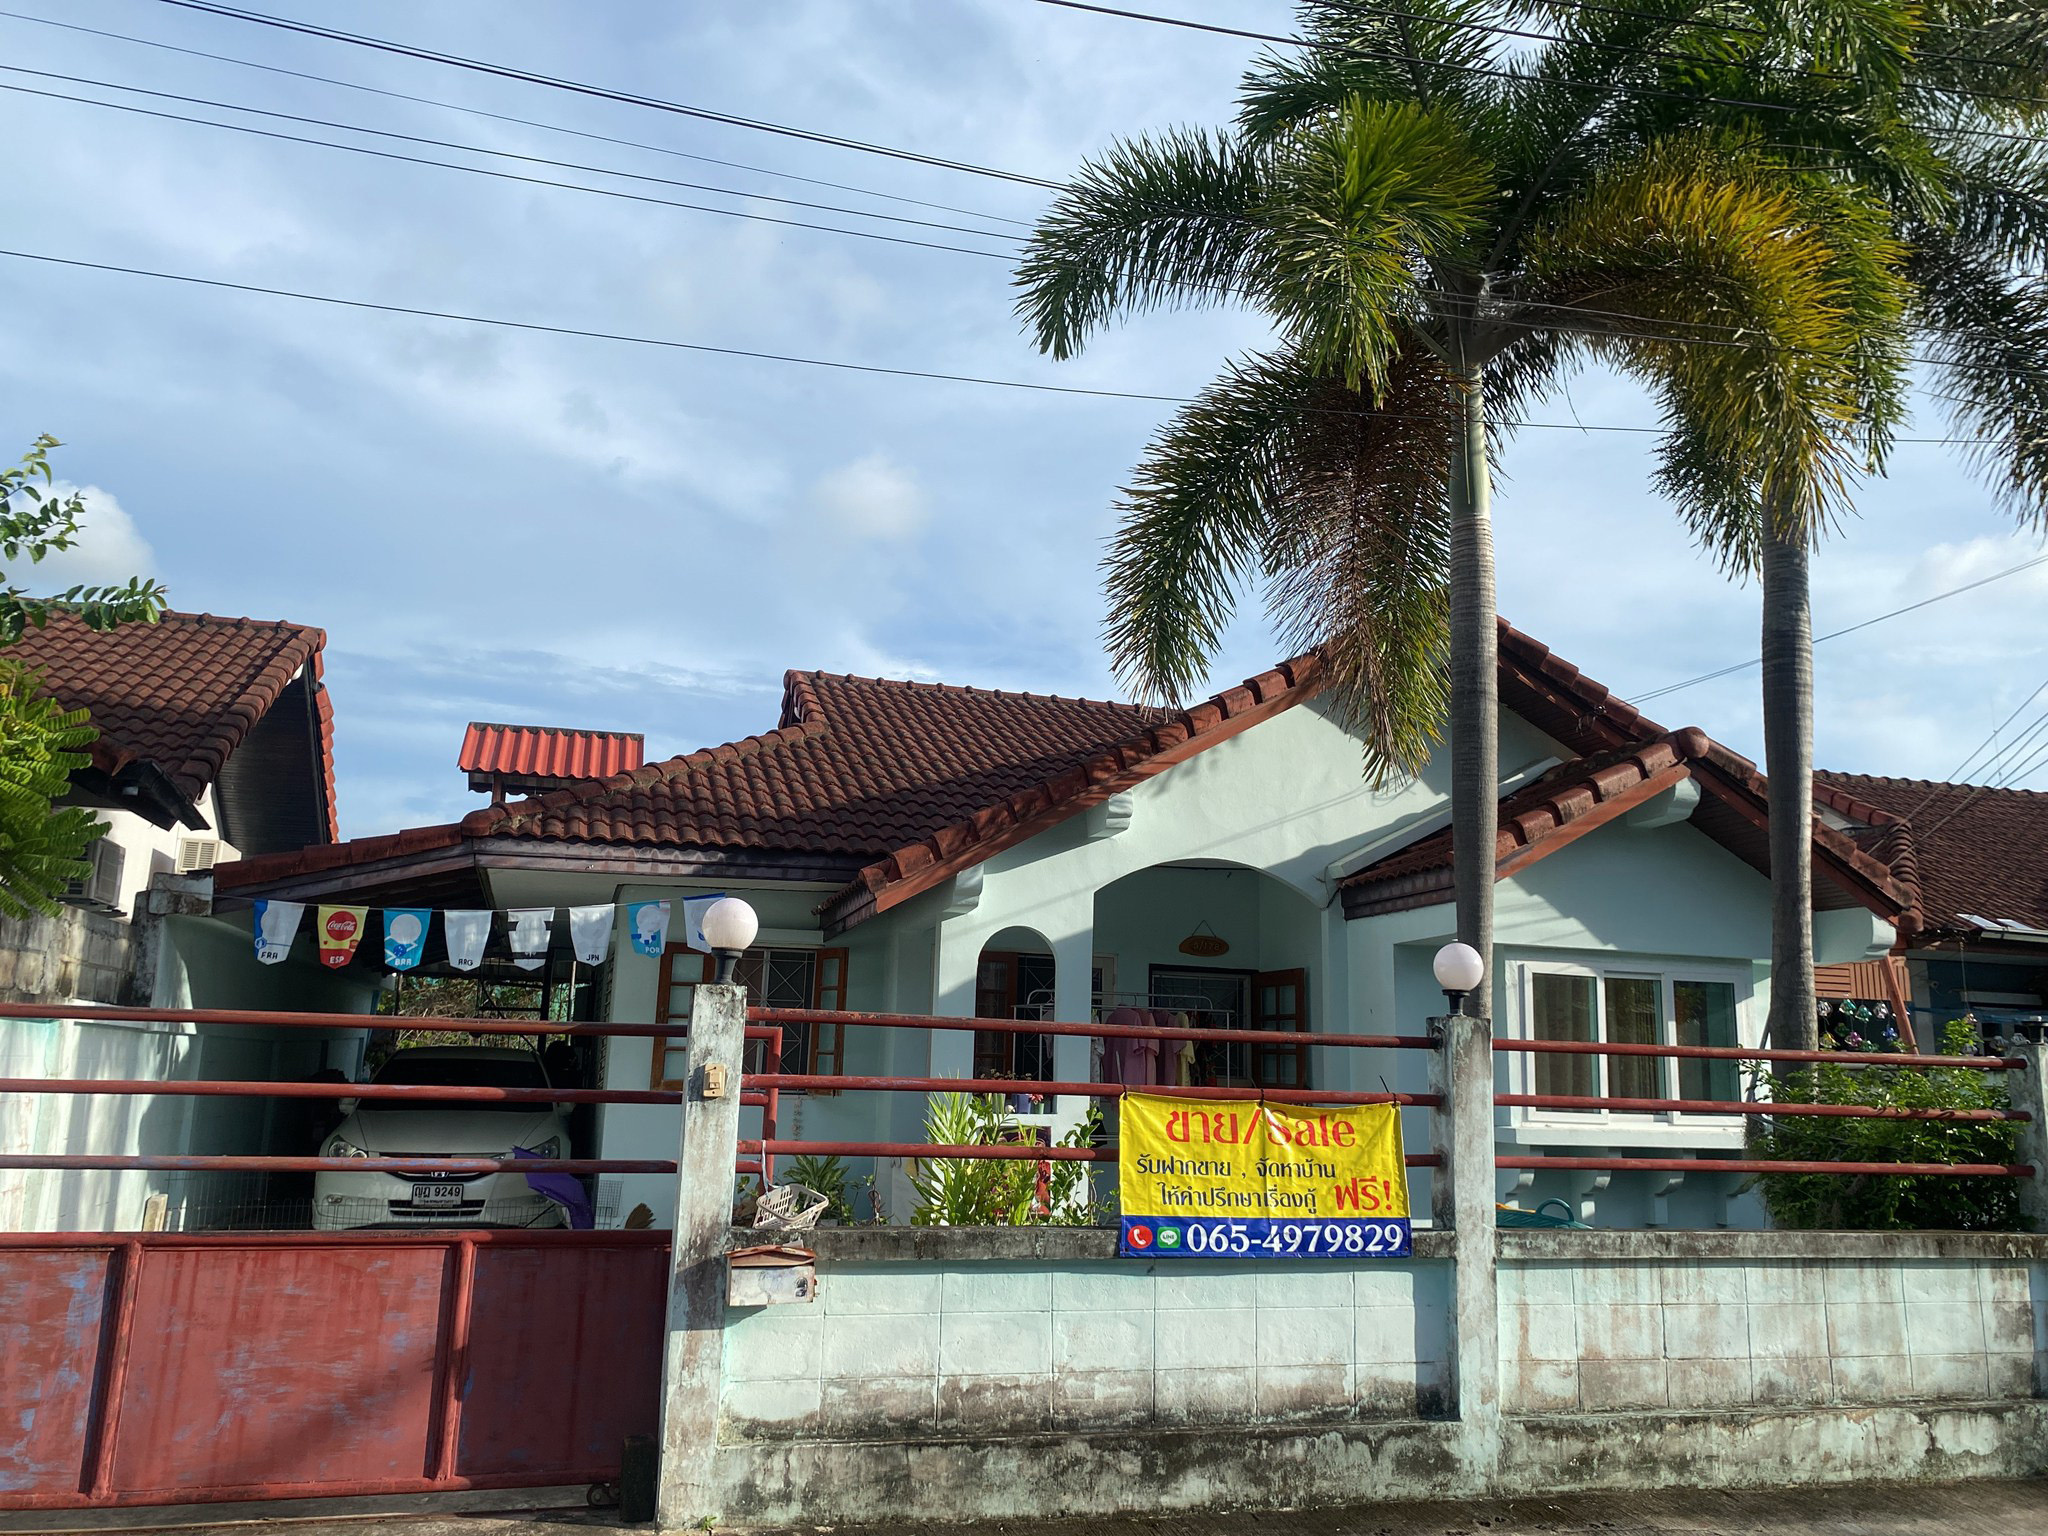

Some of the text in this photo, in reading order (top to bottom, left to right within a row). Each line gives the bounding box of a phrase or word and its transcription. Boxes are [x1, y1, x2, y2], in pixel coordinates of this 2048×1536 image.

[645, 945, 660, 954] POR
[261, 951, 278, 960] FRA
[329, 955, 345, 964] ESP
[586, 953, 600, 962] JPN
[395, 958, 412, 966] BRA
[458, 958, 474, 966] ARG
[1166, 1110, 1355, 1147] ขาย/Sale
[1136, 1153, 1231, 1177] รับฝากขาย
[1255, 1157, 1336, 1178] จัดหาบ้าน
[434, 1186, 460, 1197] 9249
[1156, 1175, 1392, 1214] ให้คำปรึกษาเรื่องกู้ ฟรี!
[1186, 1223, 1404, 1253] 065-4979829
